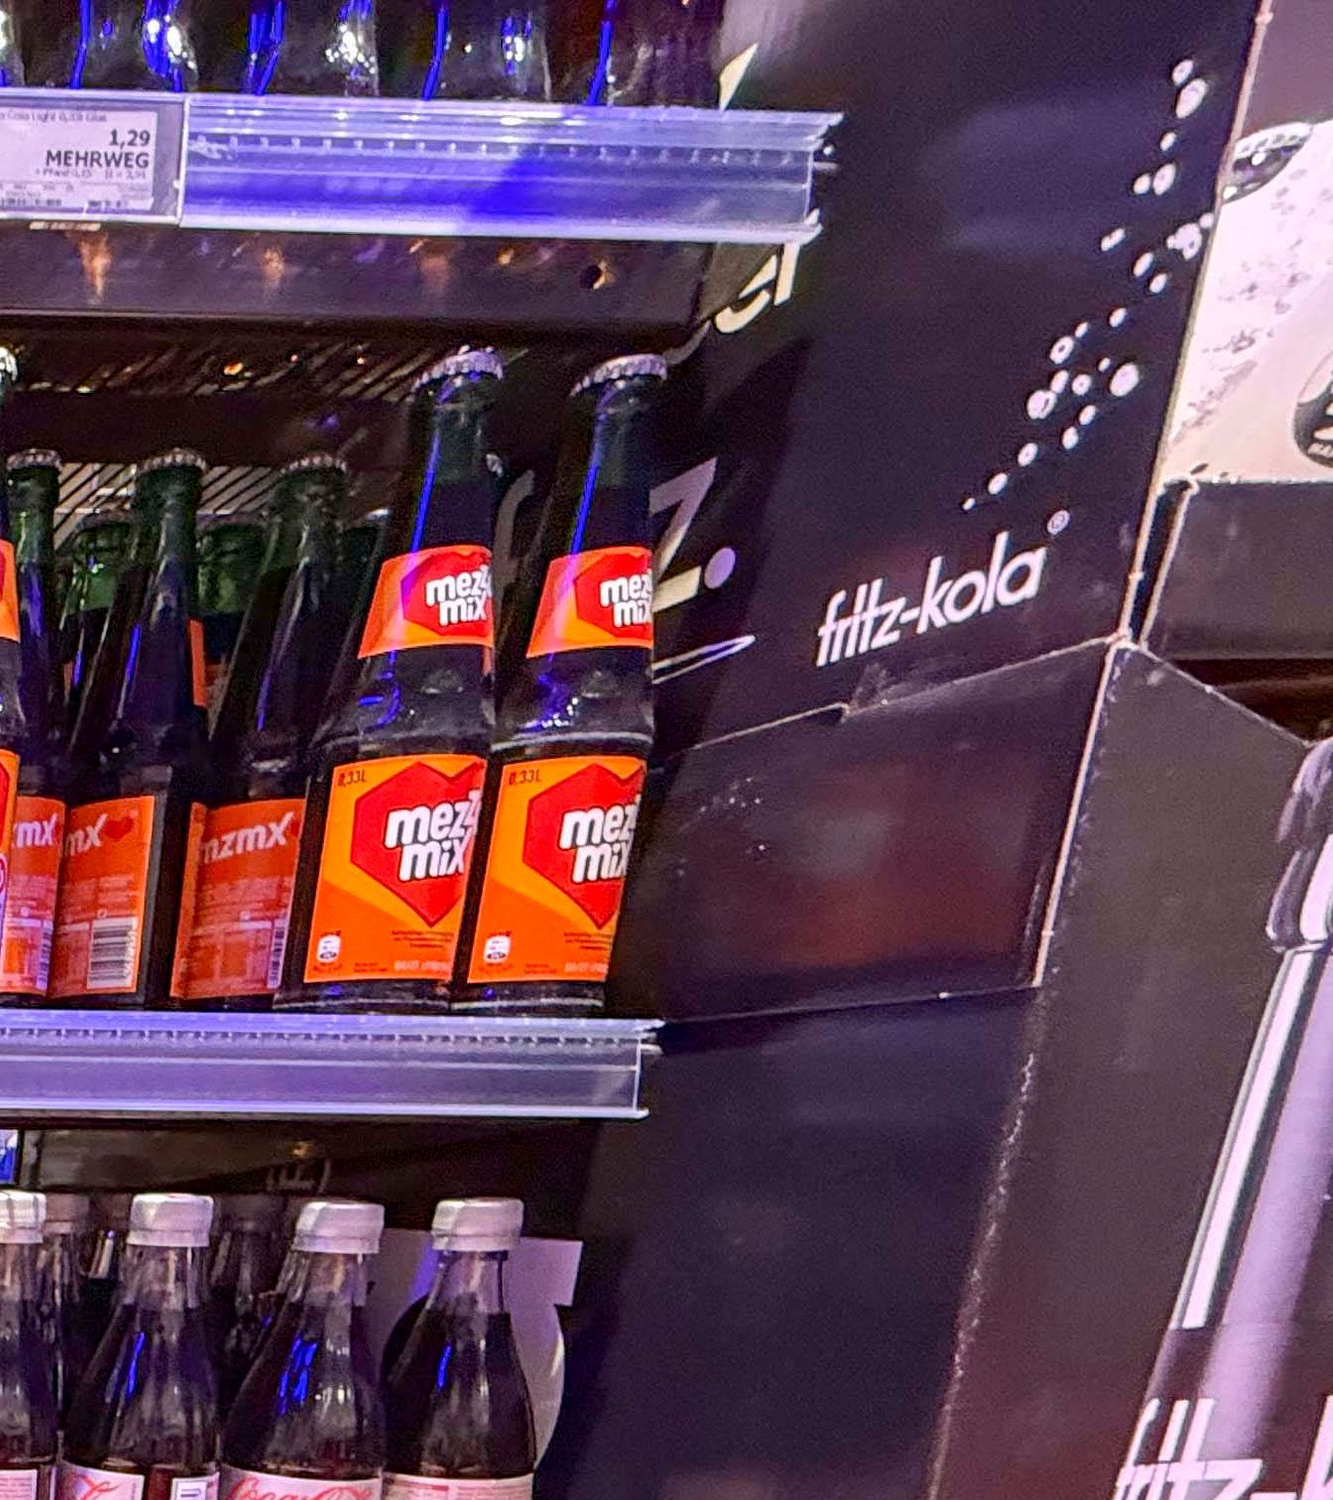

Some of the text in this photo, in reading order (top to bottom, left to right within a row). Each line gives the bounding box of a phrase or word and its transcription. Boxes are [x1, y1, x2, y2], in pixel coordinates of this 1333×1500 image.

[108, 128, 151, 149] 1,29
[45, 149, 149, 169] MEHRWEG
[600, 569, 652, 607] mez
[815, 530, 1048, 668] fritz-kola
[439, 597, 488, 627] mix
[509, 768, 543, 786] 0,33L
[398, 828, 473, 882] mix
